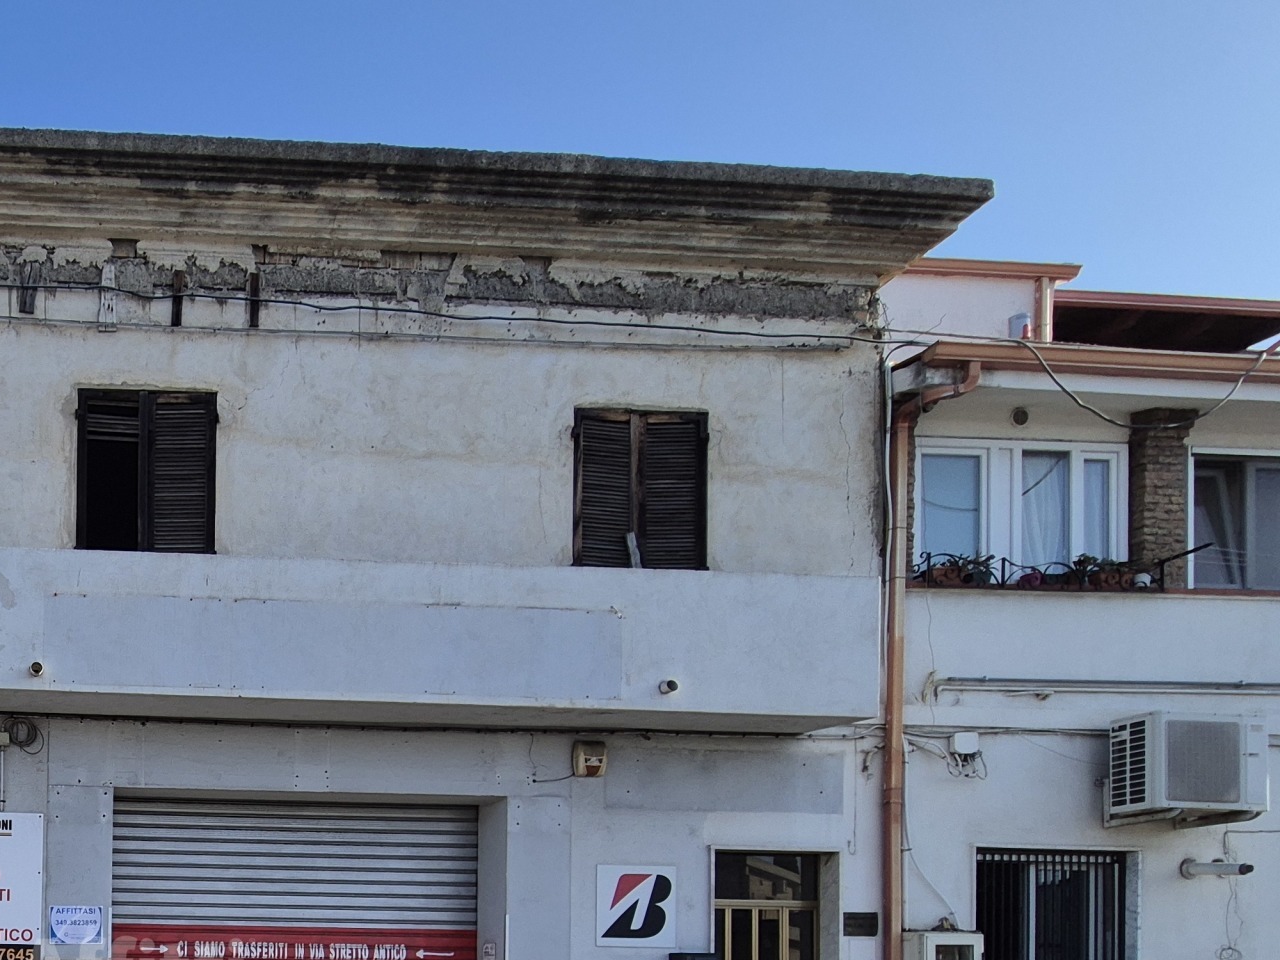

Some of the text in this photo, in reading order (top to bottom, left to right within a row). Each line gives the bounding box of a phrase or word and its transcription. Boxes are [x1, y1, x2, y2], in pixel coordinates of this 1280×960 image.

[55, 907, 96, 915] AFFITTASI
[177, 940, 407, 960] CI SIAMO TRASFERITI IN VIA STRETTO ANTICO
